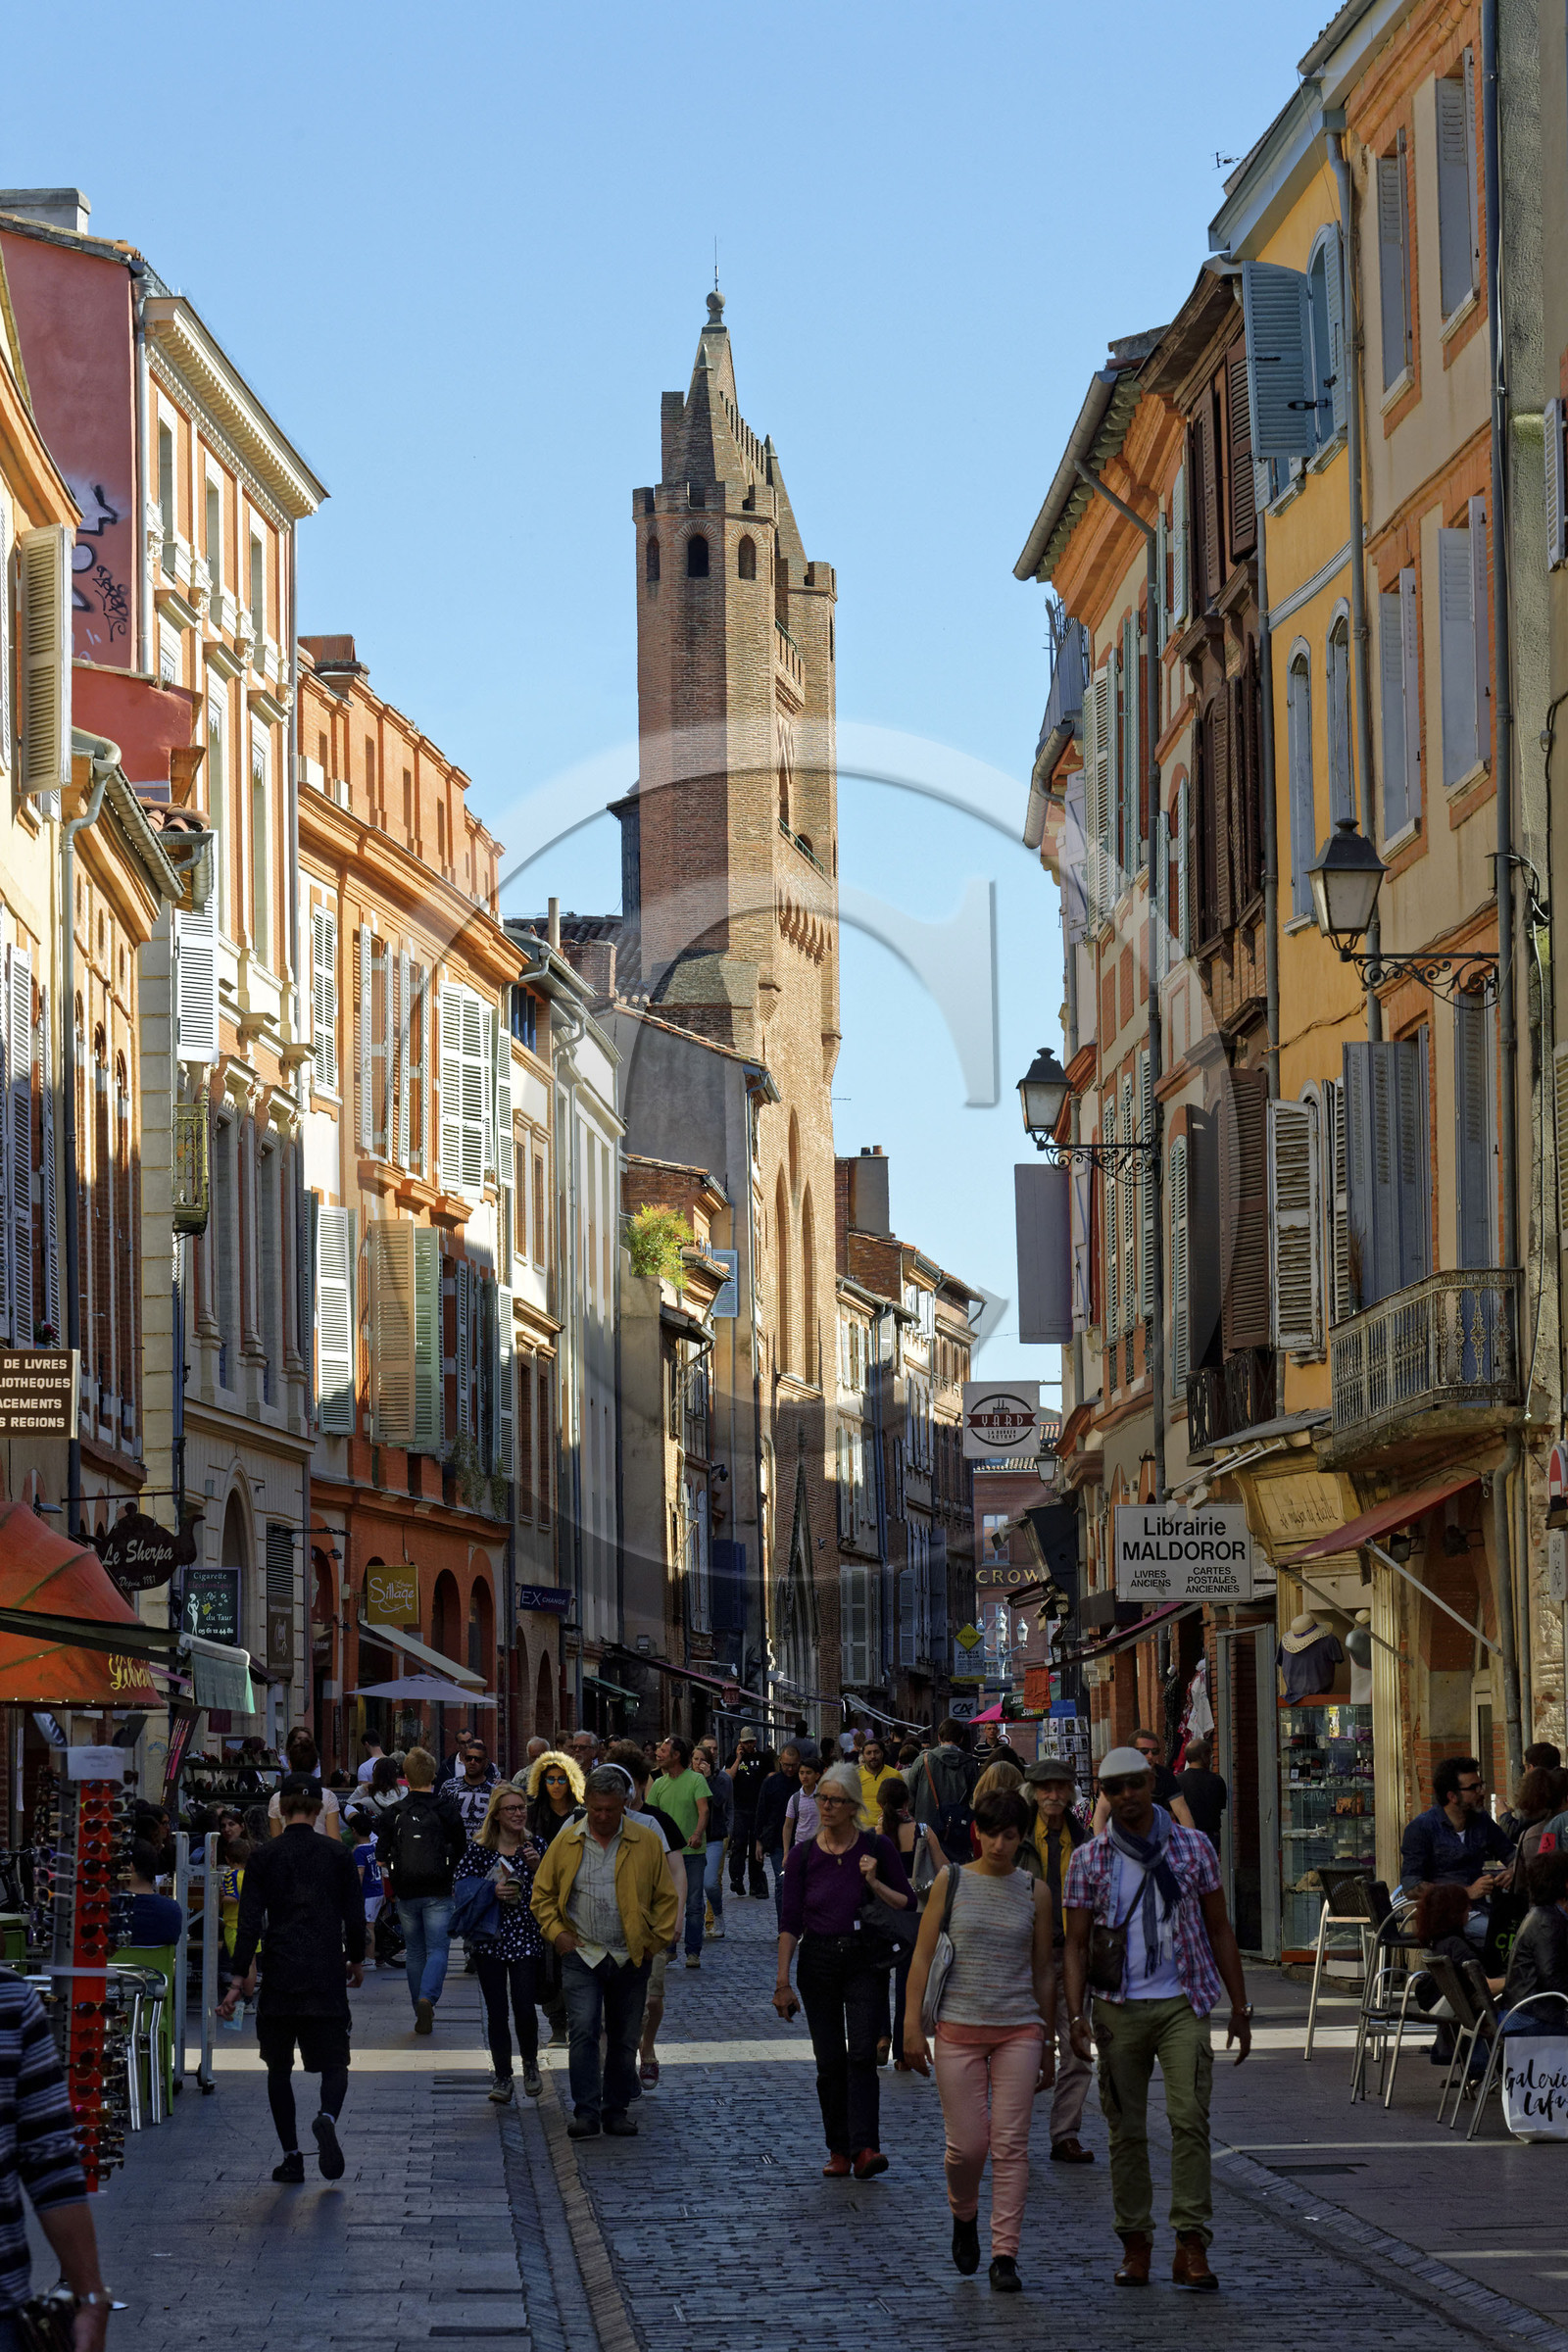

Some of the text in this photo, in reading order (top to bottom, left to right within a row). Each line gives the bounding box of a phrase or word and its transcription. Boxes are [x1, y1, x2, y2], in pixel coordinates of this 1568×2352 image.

[4, 1359, 68, 1369] DE LIVRES
[0, 1378, 71, 1389] IOTHEQUES
[11, 1417, 65, 1427] REGIONS
[982, 1415, 1023, 1426] YARD
[1144, 1517, 1226, 1536] Librairie
[102, 1539, 173, 1567] Le Sherpa
[1122, 1541, 1246, 1560] MALDOROR
[193, 1571, 226, 1581] Cigarette
[1134, 1570, 1166, 1579] LIVRES
[1130, 1579, 1171, 1588] ANCIENS
[1187, 1576, 1237, 1585] POSTALES
[1185, 1585, 1240, 1593] ANCIENNES
[369, 1577, 415, 1612] Sillage
[458, 1791, 490, 1819] 75
